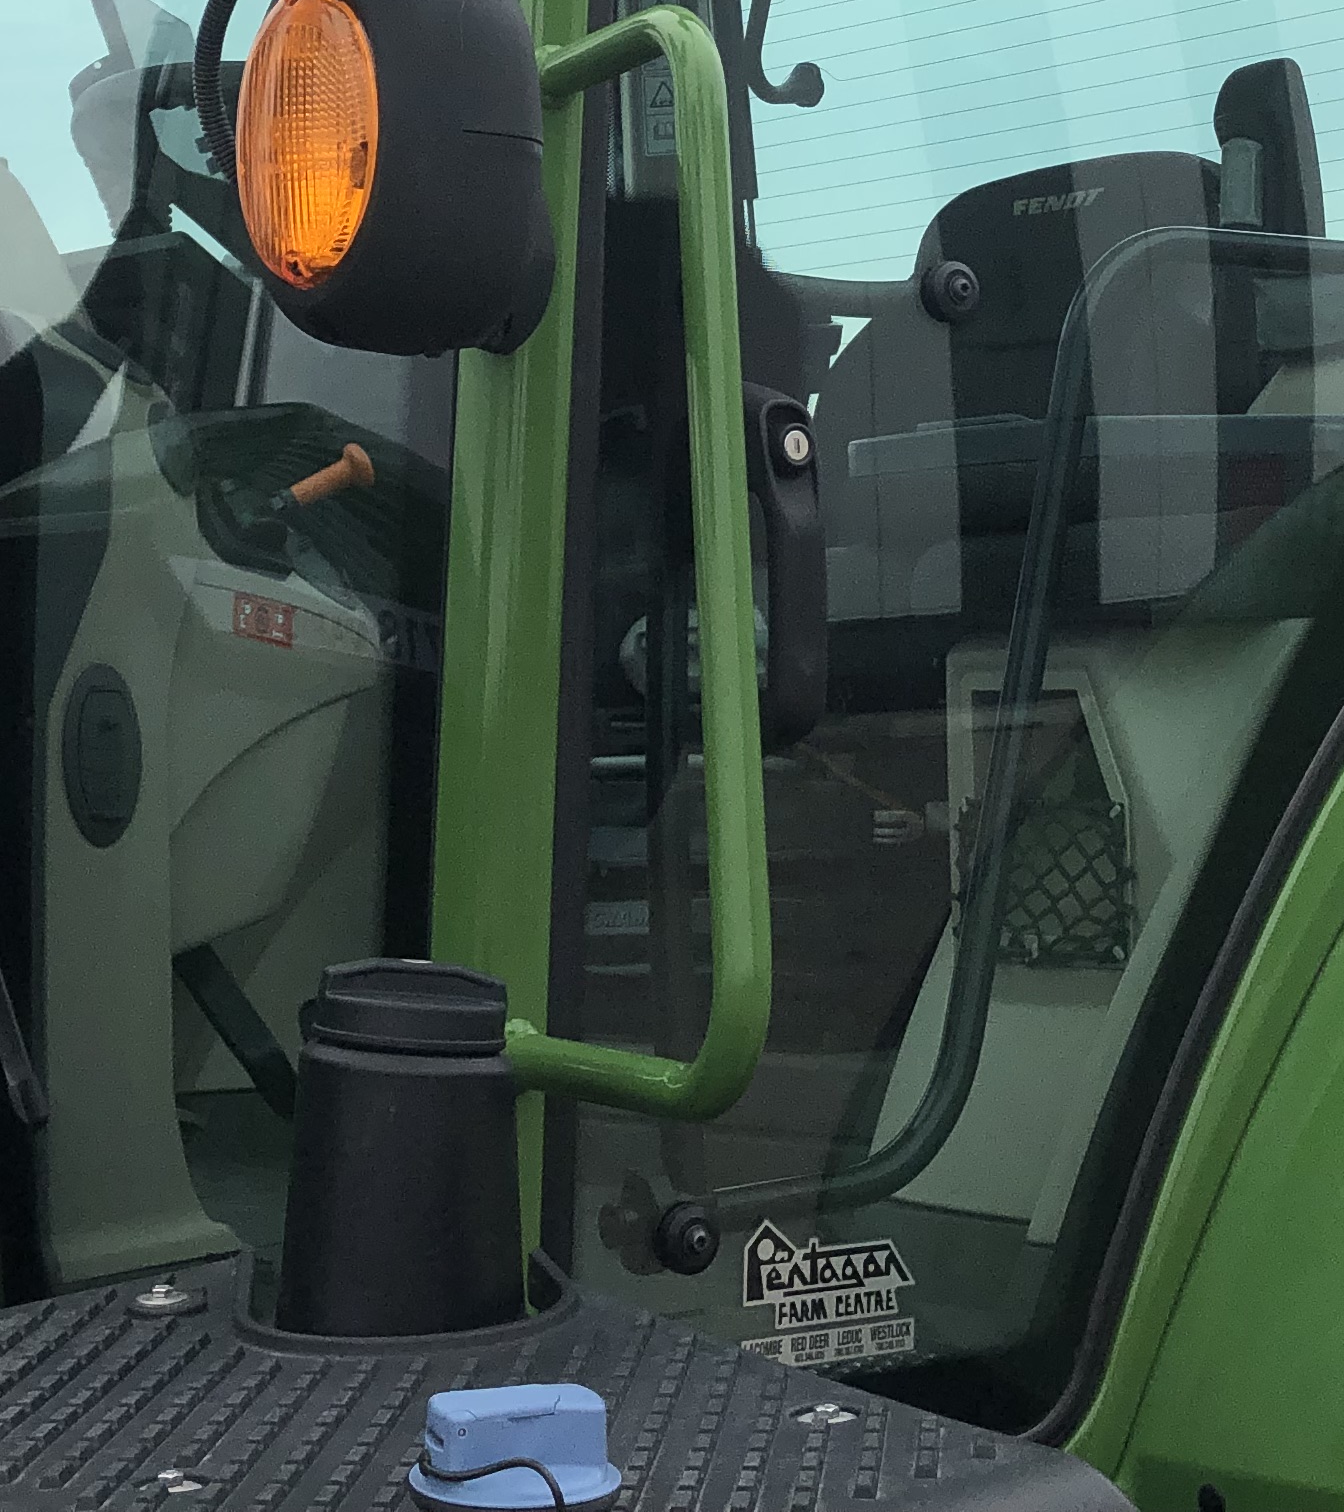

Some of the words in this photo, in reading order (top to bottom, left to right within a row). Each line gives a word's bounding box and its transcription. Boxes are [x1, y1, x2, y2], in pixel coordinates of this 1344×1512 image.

[1012, 187, 1105, 216] FENDT
[778, 1298, 828, 1326] FARM
[835, 1289, 895, 1318] CENTRE
[791, 1336, 807, 1353] RED
[809, 1333, 830, 1350] DEER
[837, 1328, 863, 1346] LEDUC
[870, 1321, 912, 1342] WESTLOCK
